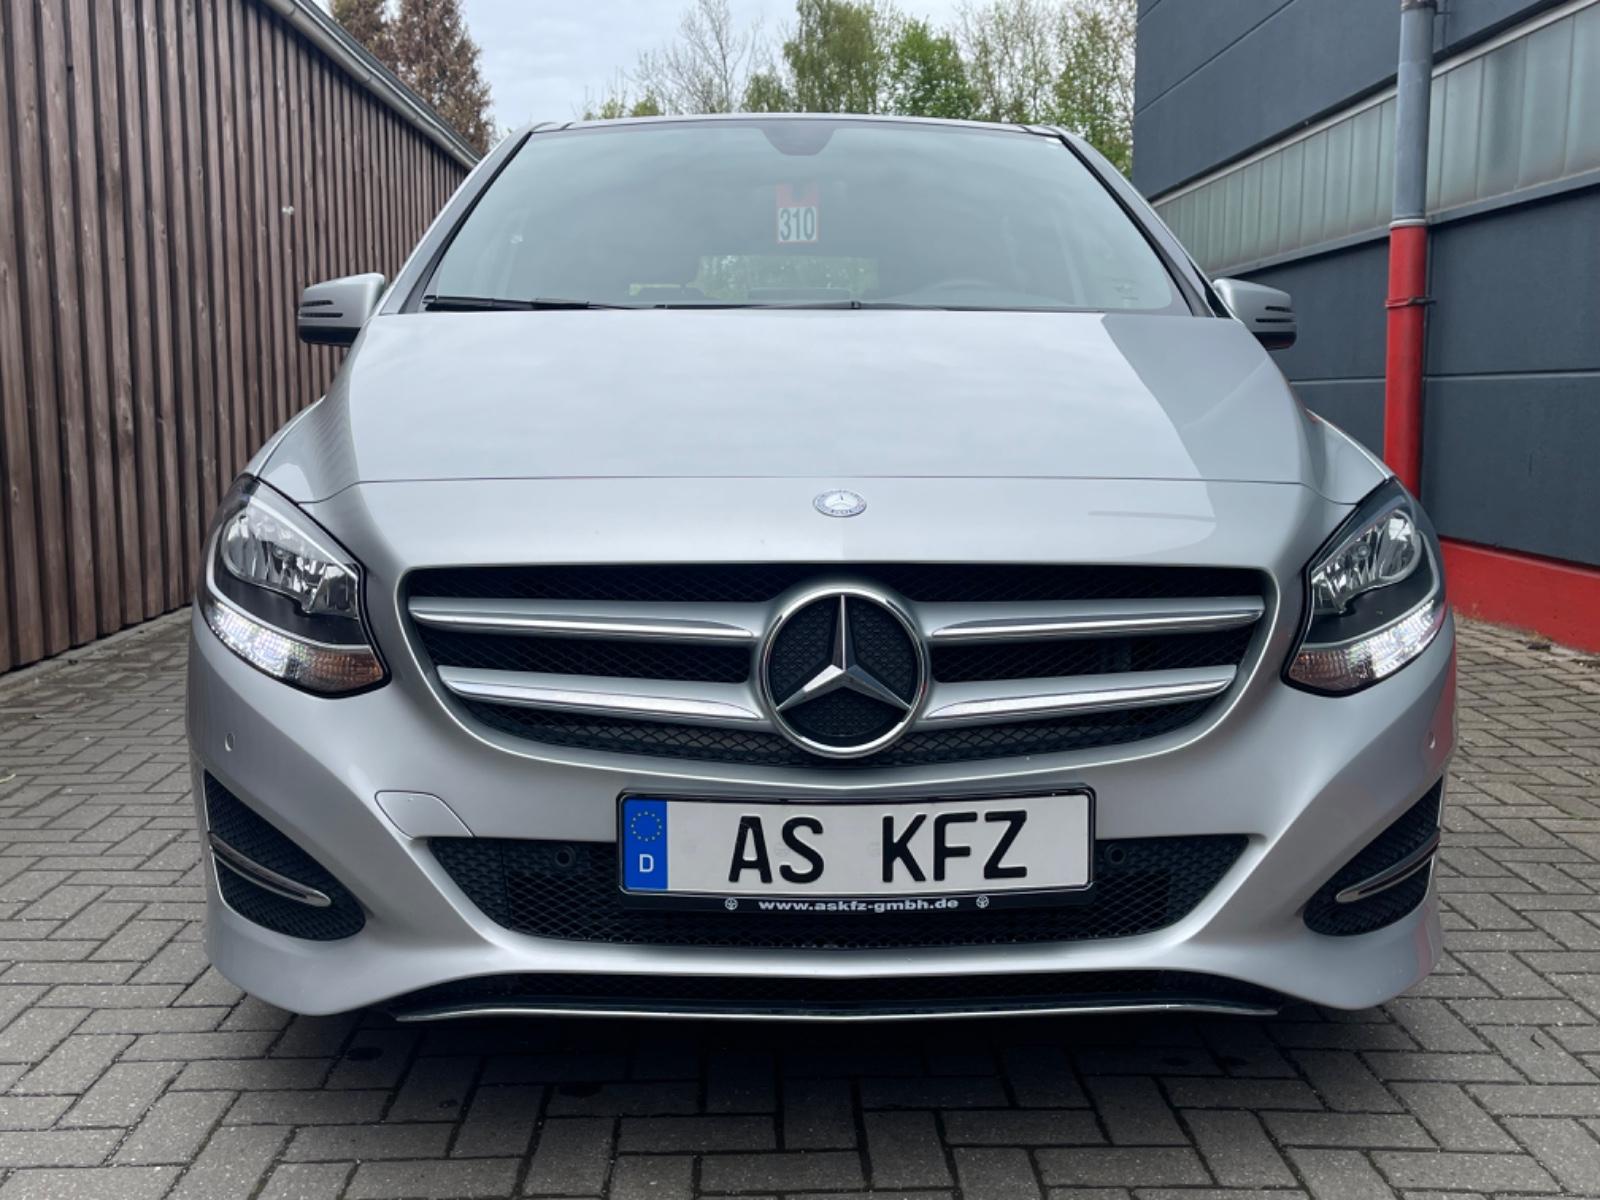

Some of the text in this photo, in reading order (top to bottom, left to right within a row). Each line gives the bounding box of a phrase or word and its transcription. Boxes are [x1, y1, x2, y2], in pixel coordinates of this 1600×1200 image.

[779, 208, 815, 241] 310
[728, 810, 1028, 884] AS KFZ
[639, 854, 654, 873] D
[758, 899, 959, 913] www.askfz-gmbh.de
